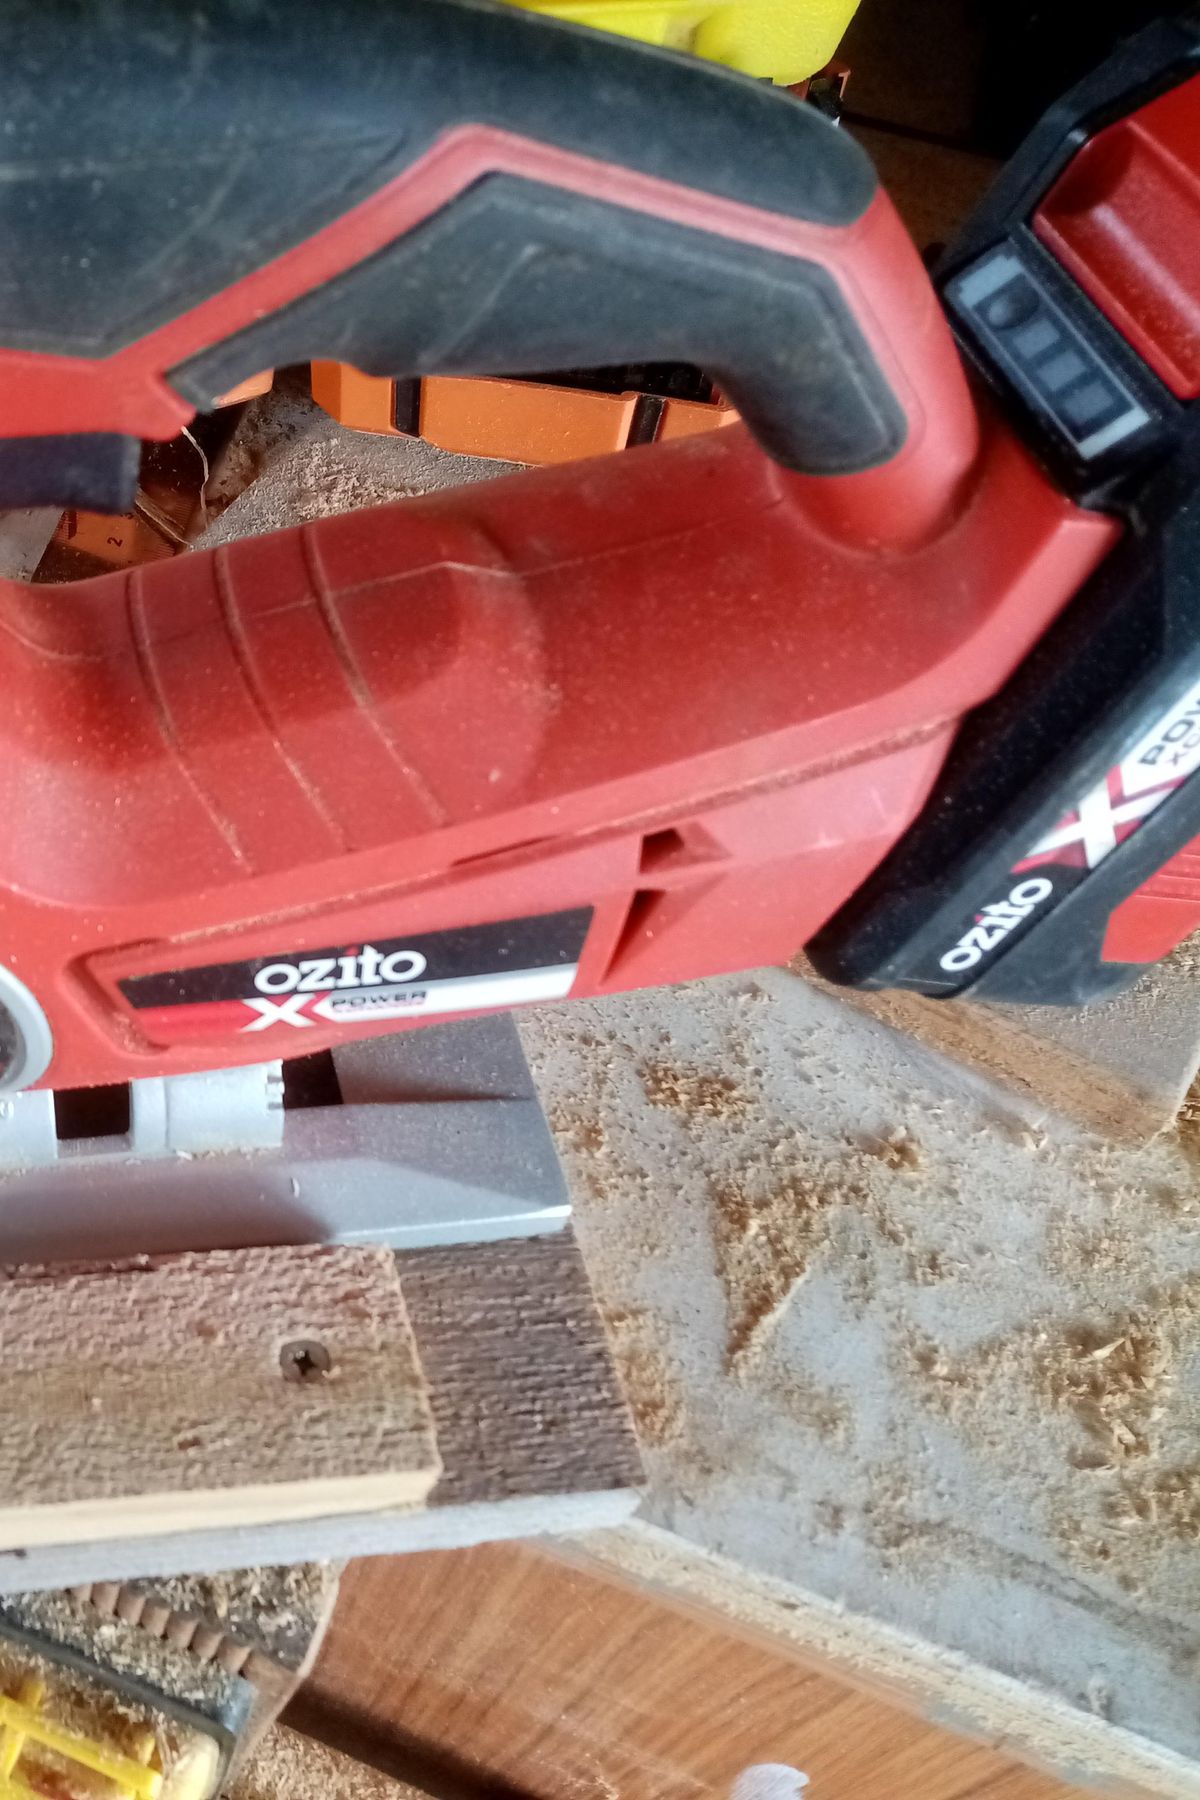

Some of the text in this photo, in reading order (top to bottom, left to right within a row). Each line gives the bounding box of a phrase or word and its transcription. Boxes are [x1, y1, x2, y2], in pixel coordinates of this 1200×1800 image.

[106, 537, 123, 547] 2
[940, 877, 1054, 972] ozito
[254, 944, 428, 995] ozito
[239, 990, 427, 1033] X POWER
